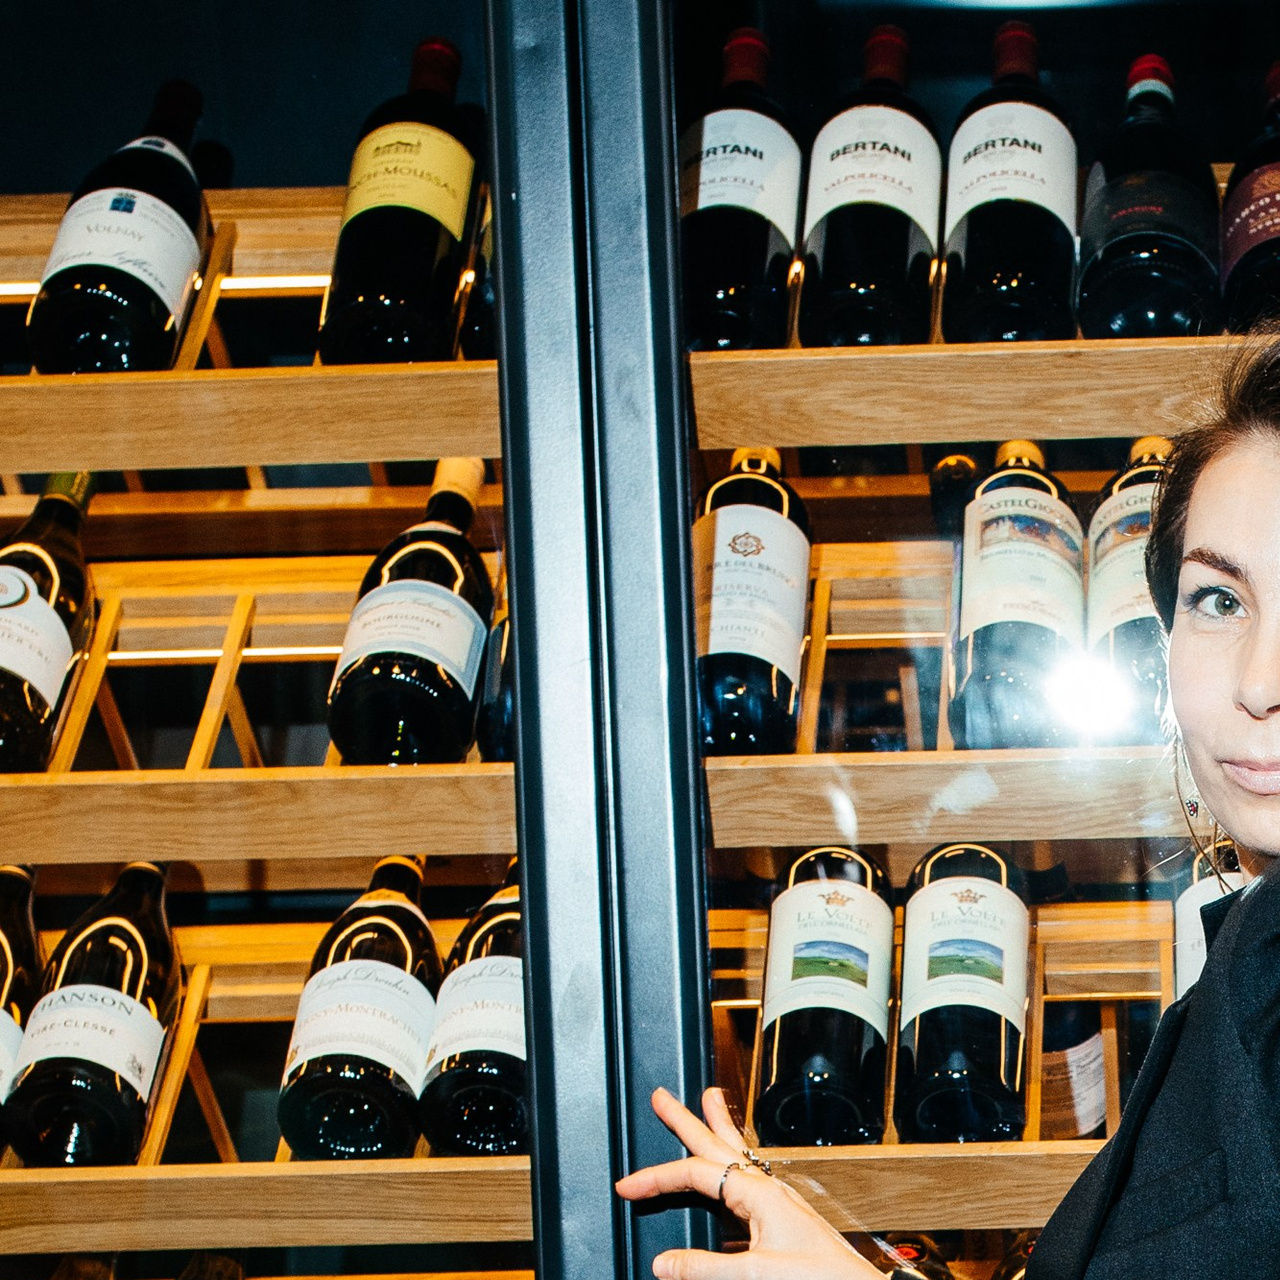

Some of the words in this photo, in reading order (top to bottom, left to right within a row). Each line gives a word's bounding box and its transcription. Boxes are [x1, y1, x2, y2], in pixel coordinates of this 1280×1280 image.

[829, 139, 912, 163] BERTANI
[962, 136, 1043, 165] BERTANI
[797, 911, 815, 923] LE
[930, 910, 948, 922] LE
[32, 990, 134, 1020] CHANSON
